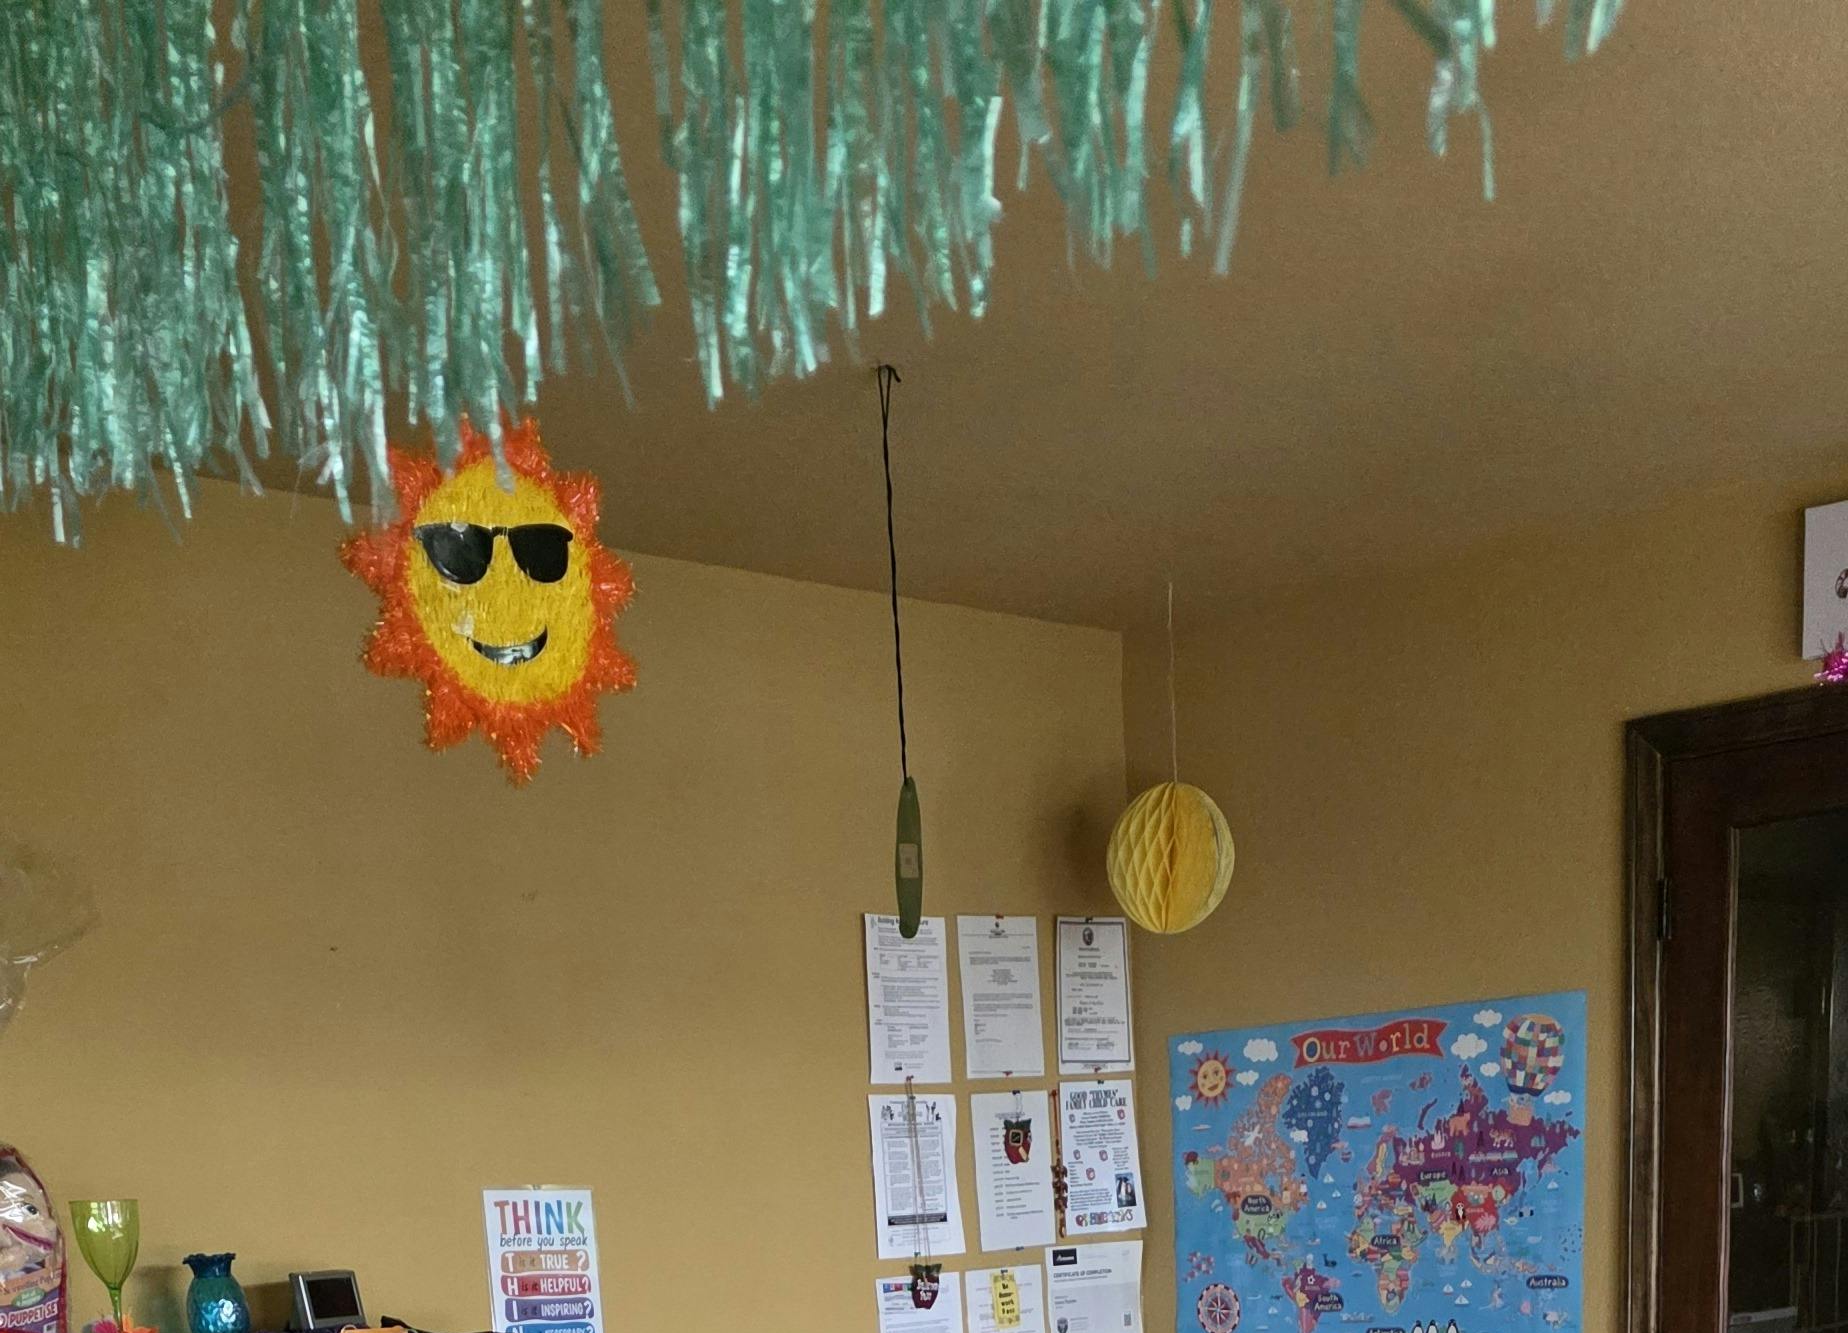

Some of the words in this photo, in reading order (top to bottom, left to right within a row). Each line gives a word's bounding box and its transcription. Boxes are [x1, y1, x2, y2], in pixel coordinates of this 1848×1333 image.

[1303, 1037, 1350, 1062] Our
[1354, 1023, 1430, 1056] World
[1420, 1171, 1446, 1180] Europe
[1247, 1196, 1267, 1204] North
[1243, 1204, 1270, 1212] America
[494, 1200, 584, 1235] THINK
[500, 1231, 533, 1247] before
[537, 1236, 554, 1252] you
[560, 1231, 588, 1251] speak
[1373, 1237, 1398, 1245] Africa
[505, 1252, 515, 1272] T
[507, 1278, 519, 1295] H
[1529, 1278, 1567, 1287] Australia
[9, 1305, 44, 1326] PUPPET
[45, 1298, 59, 1317] SE
[1314, 1302, 1342, 1311] America
